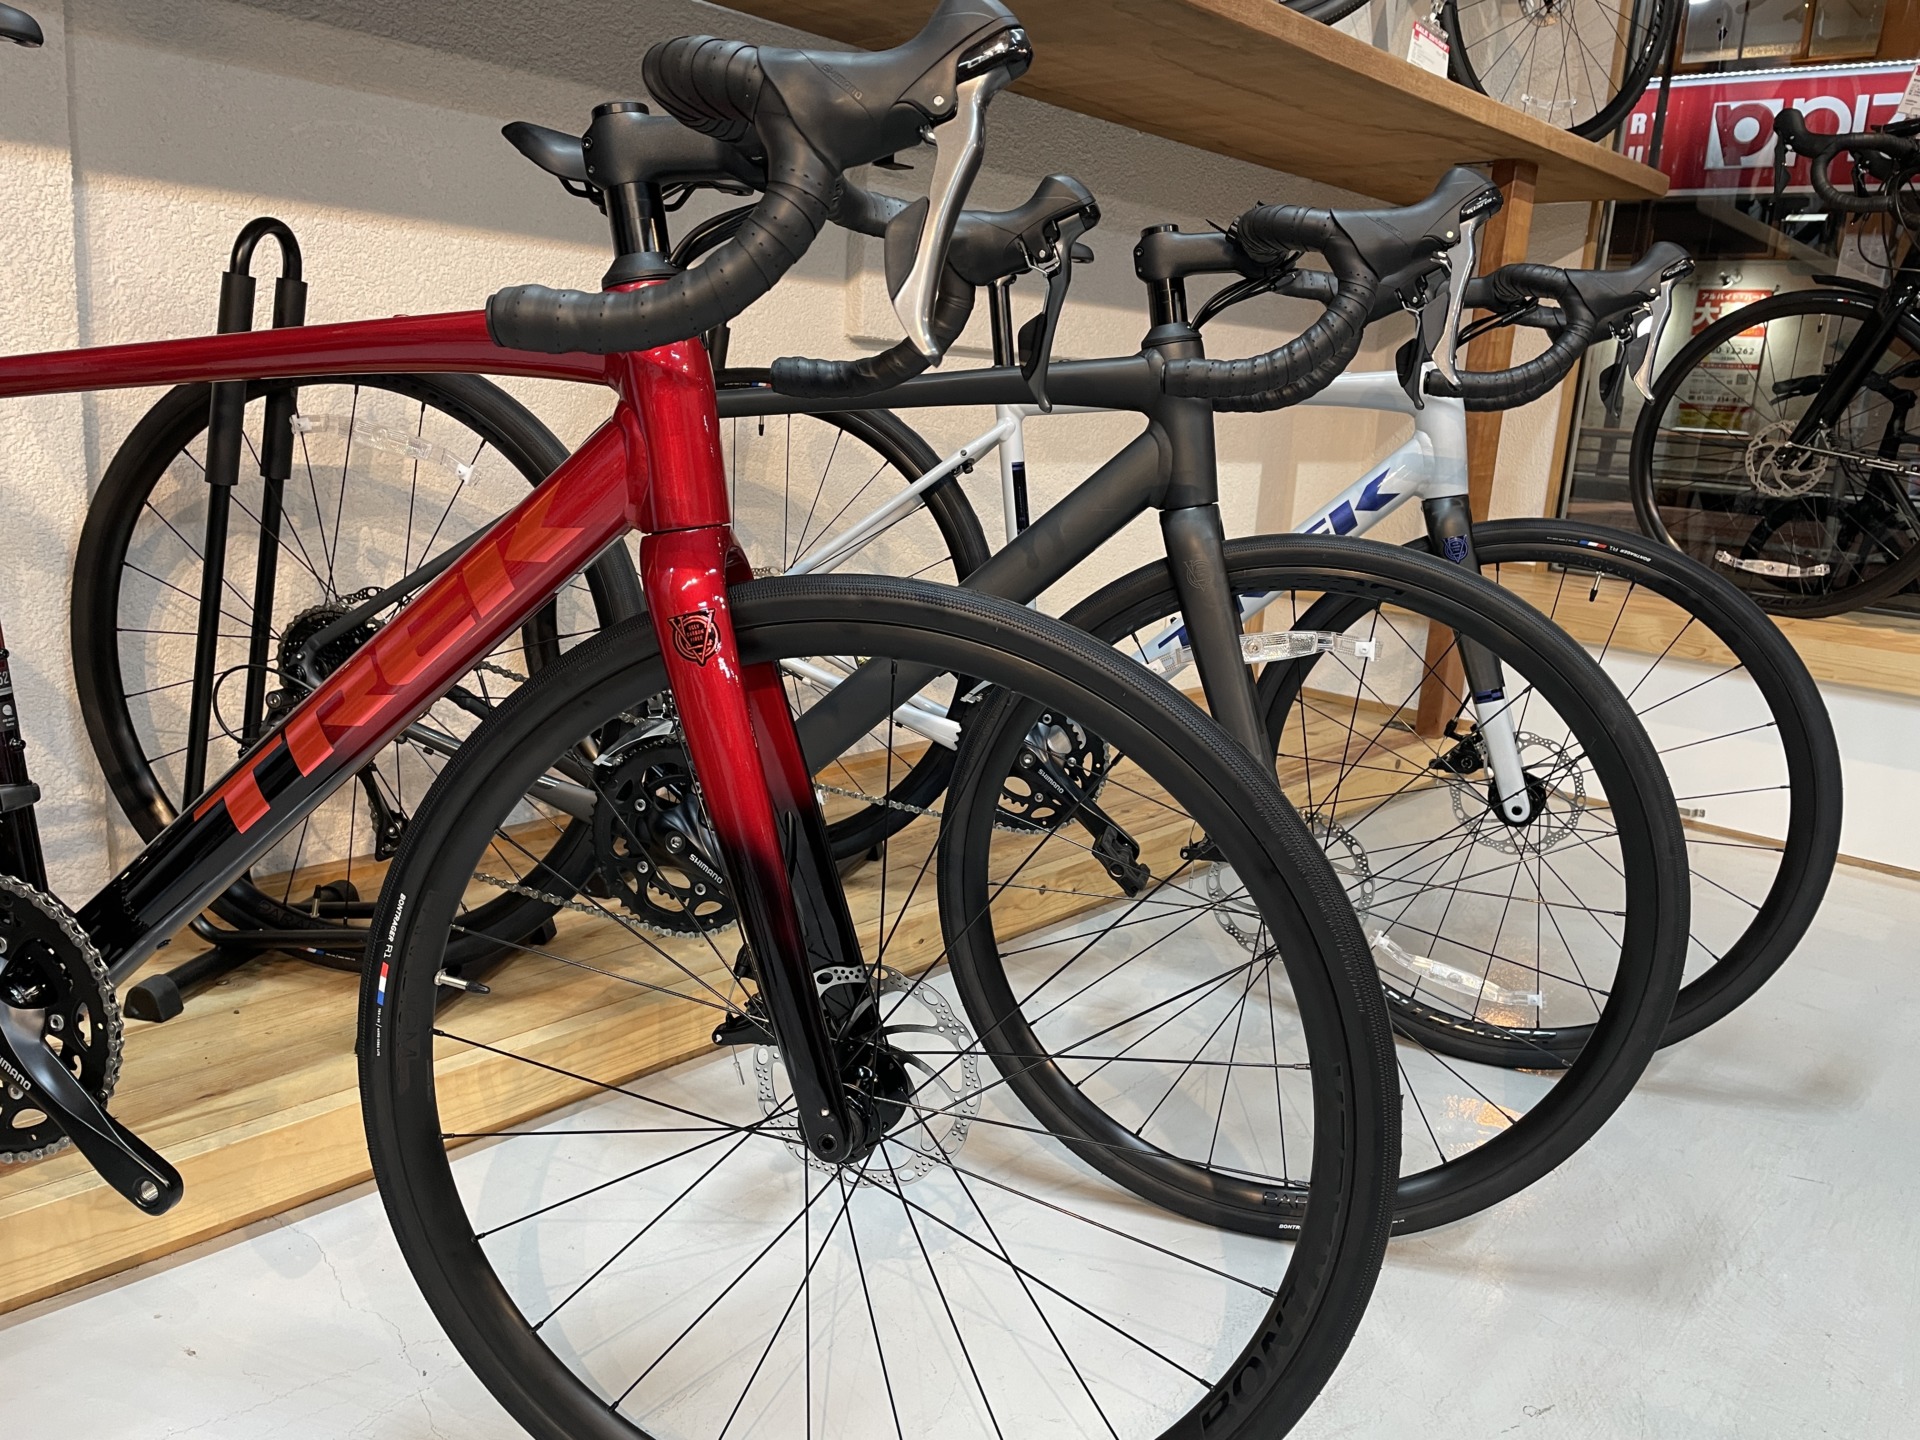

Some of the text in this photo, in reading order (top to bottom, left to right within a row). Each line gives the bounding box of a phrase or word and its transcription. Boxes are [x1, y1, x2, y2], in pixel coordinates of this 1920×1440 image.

[193, 477, 585, 835] TREK
[1037, 768, 1064, 794] SHIMANO
[688, 853, 724, 884] SHIMANO
[383, 892, 407, 959] BONTRAGER R1
